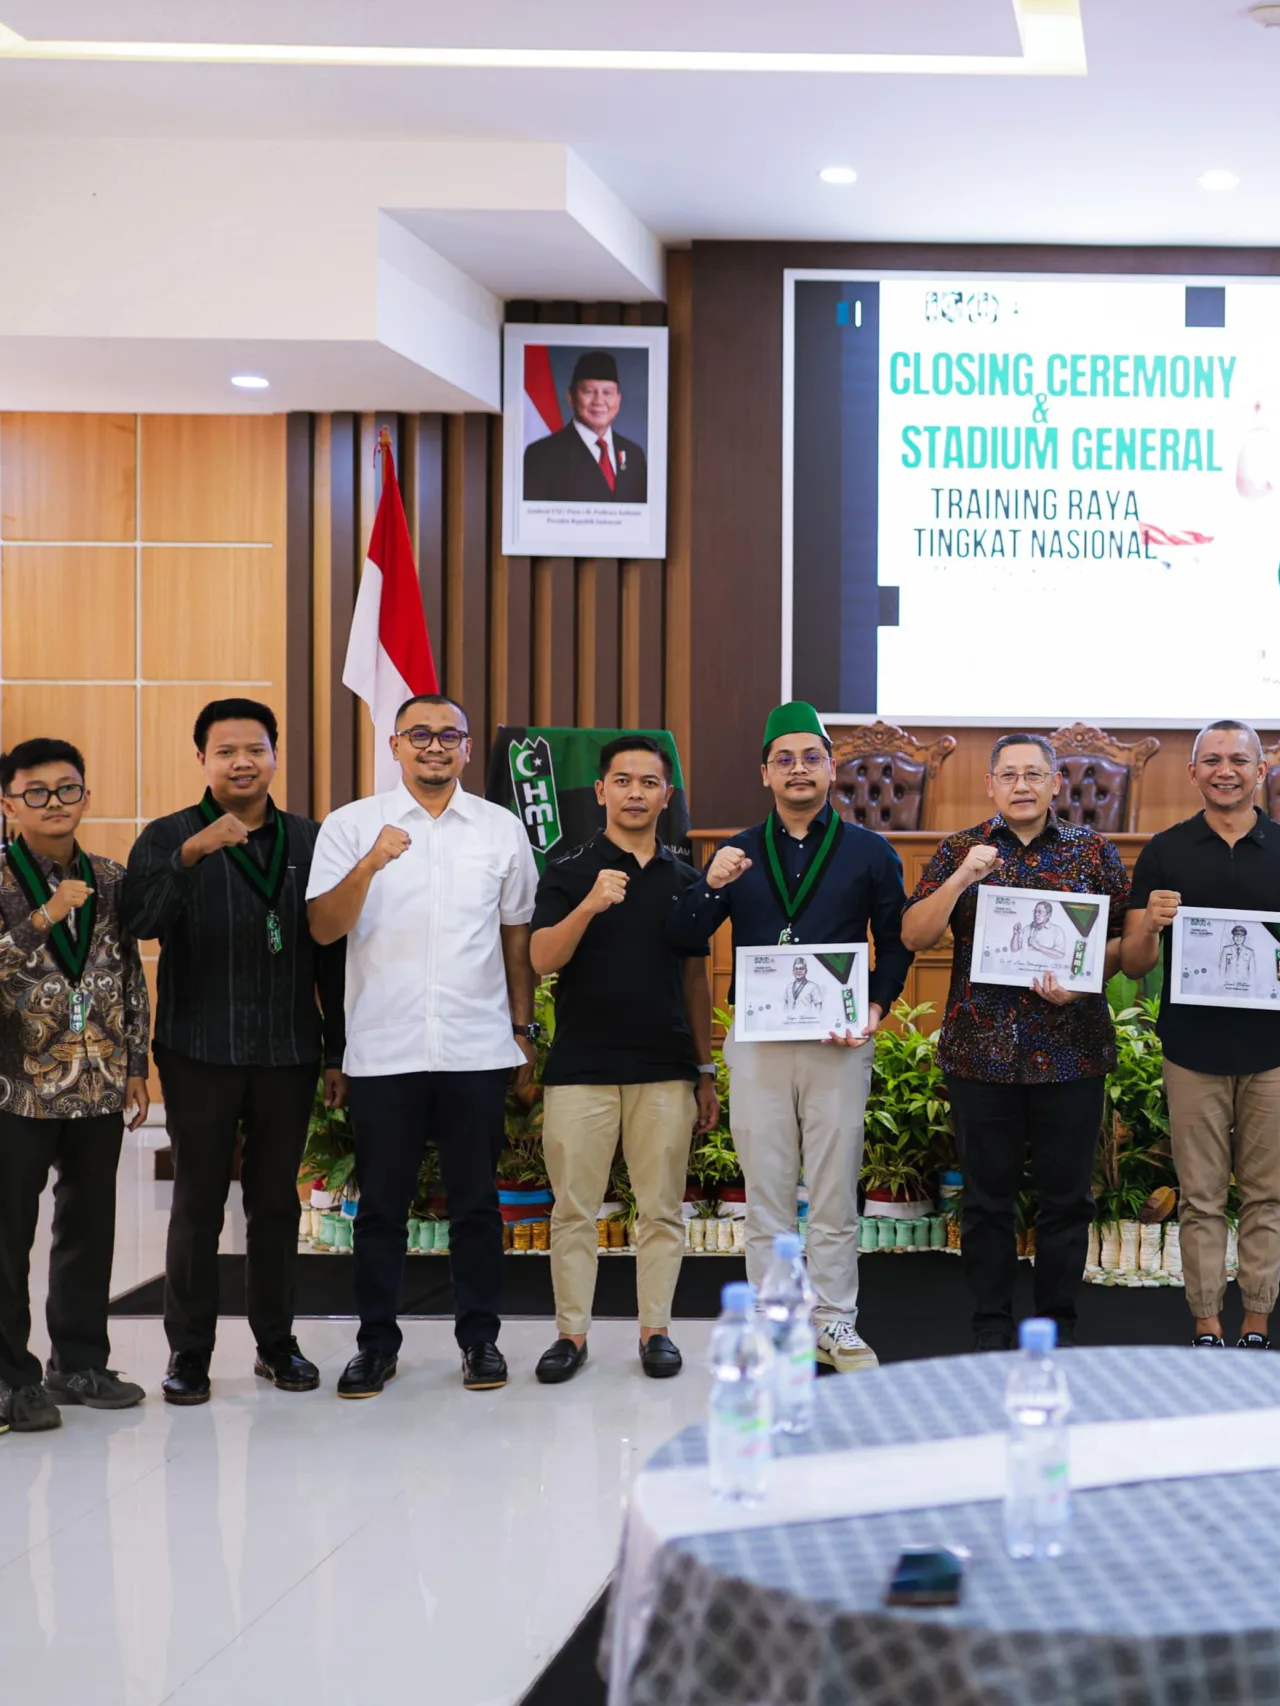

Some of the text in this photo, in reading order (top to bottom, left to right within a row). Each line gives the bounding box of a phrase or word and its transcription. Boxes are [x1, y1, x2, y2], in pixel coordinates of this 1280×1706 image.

[889, 351, 1237, 398] CLOSING CEREMONY
[1031, 393, 1050, 424] &
[901, 425, 1223, 472] STADIUM GENERAL
[931, 488, 1140, 522] TRAINING RAYA
[913, 528, 1158, 560] TINGKAT NASIONAL
